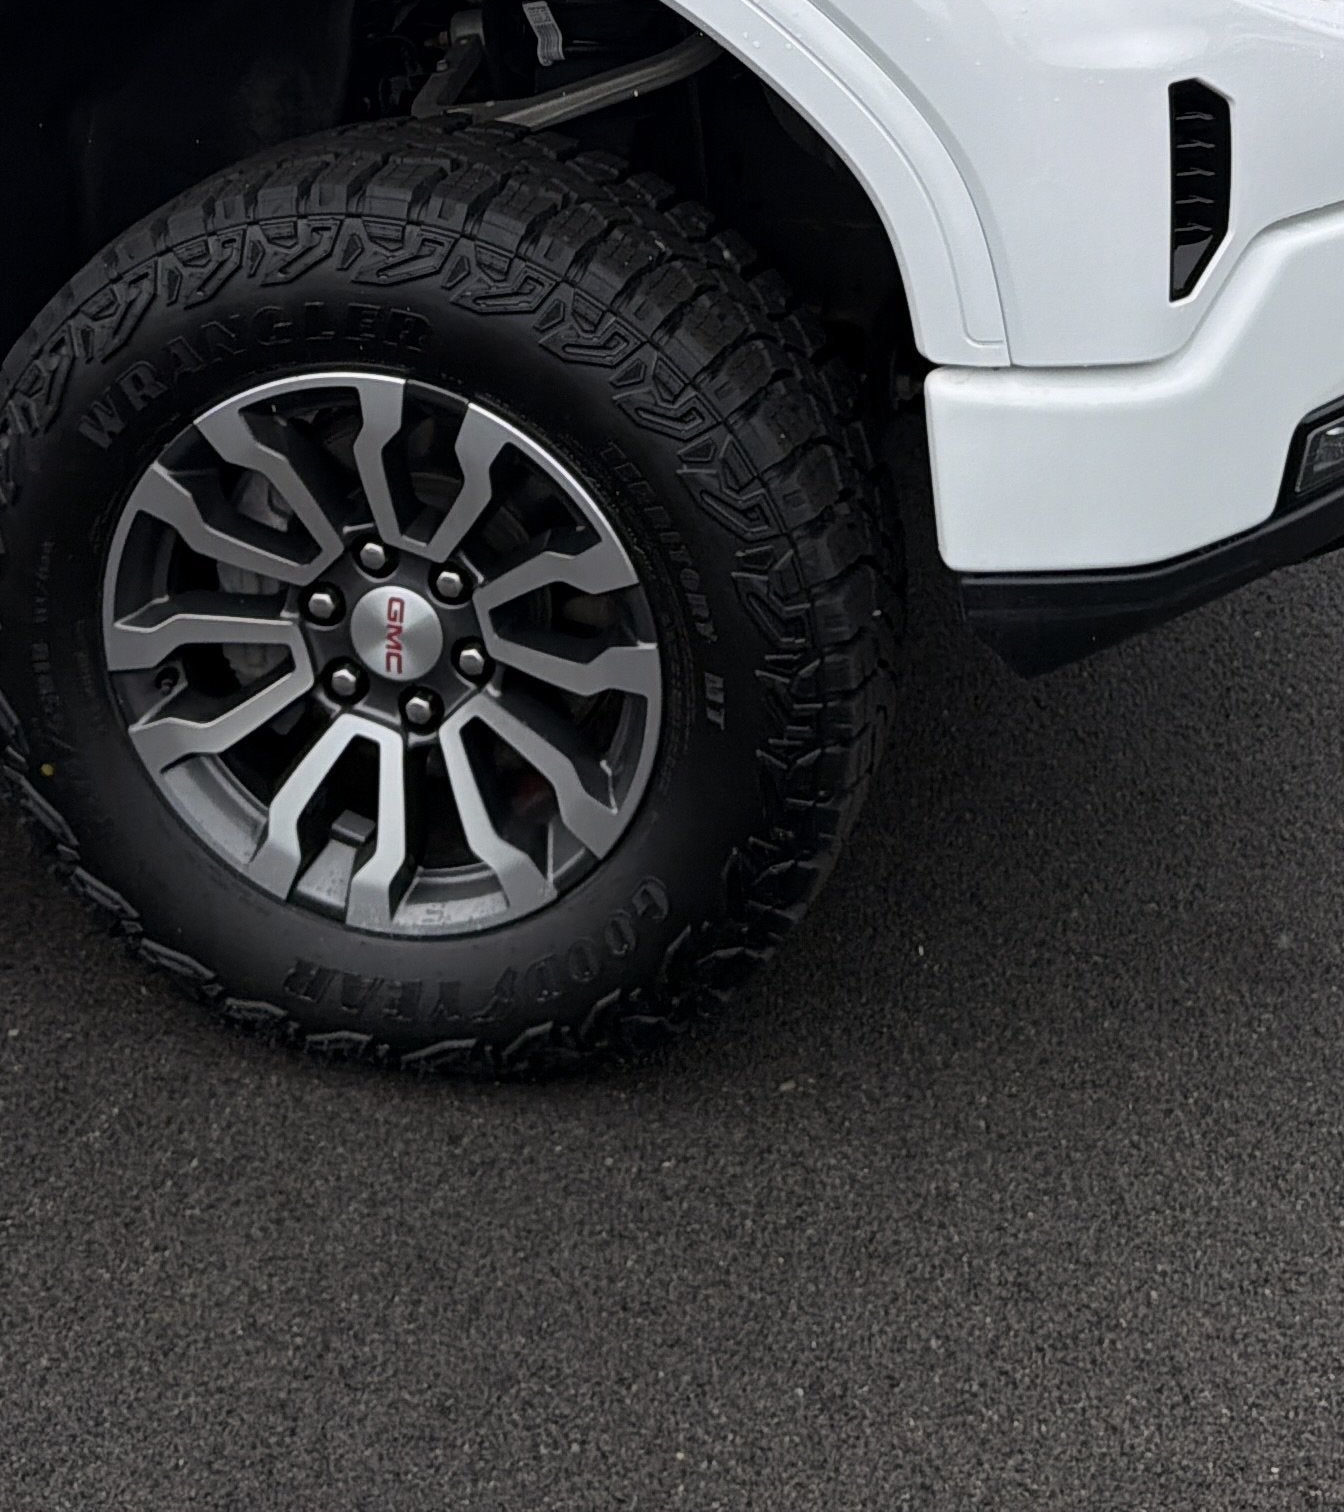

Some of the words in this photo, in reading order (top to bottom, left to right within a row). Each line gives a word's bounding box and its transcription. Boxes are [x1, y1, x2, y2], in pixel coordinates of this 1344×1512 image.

[78, 301, 432, 449] WRANGLER
[385, 596, 405, 675] GMC
[282, 875, 670, 1024] GOODYEAR
